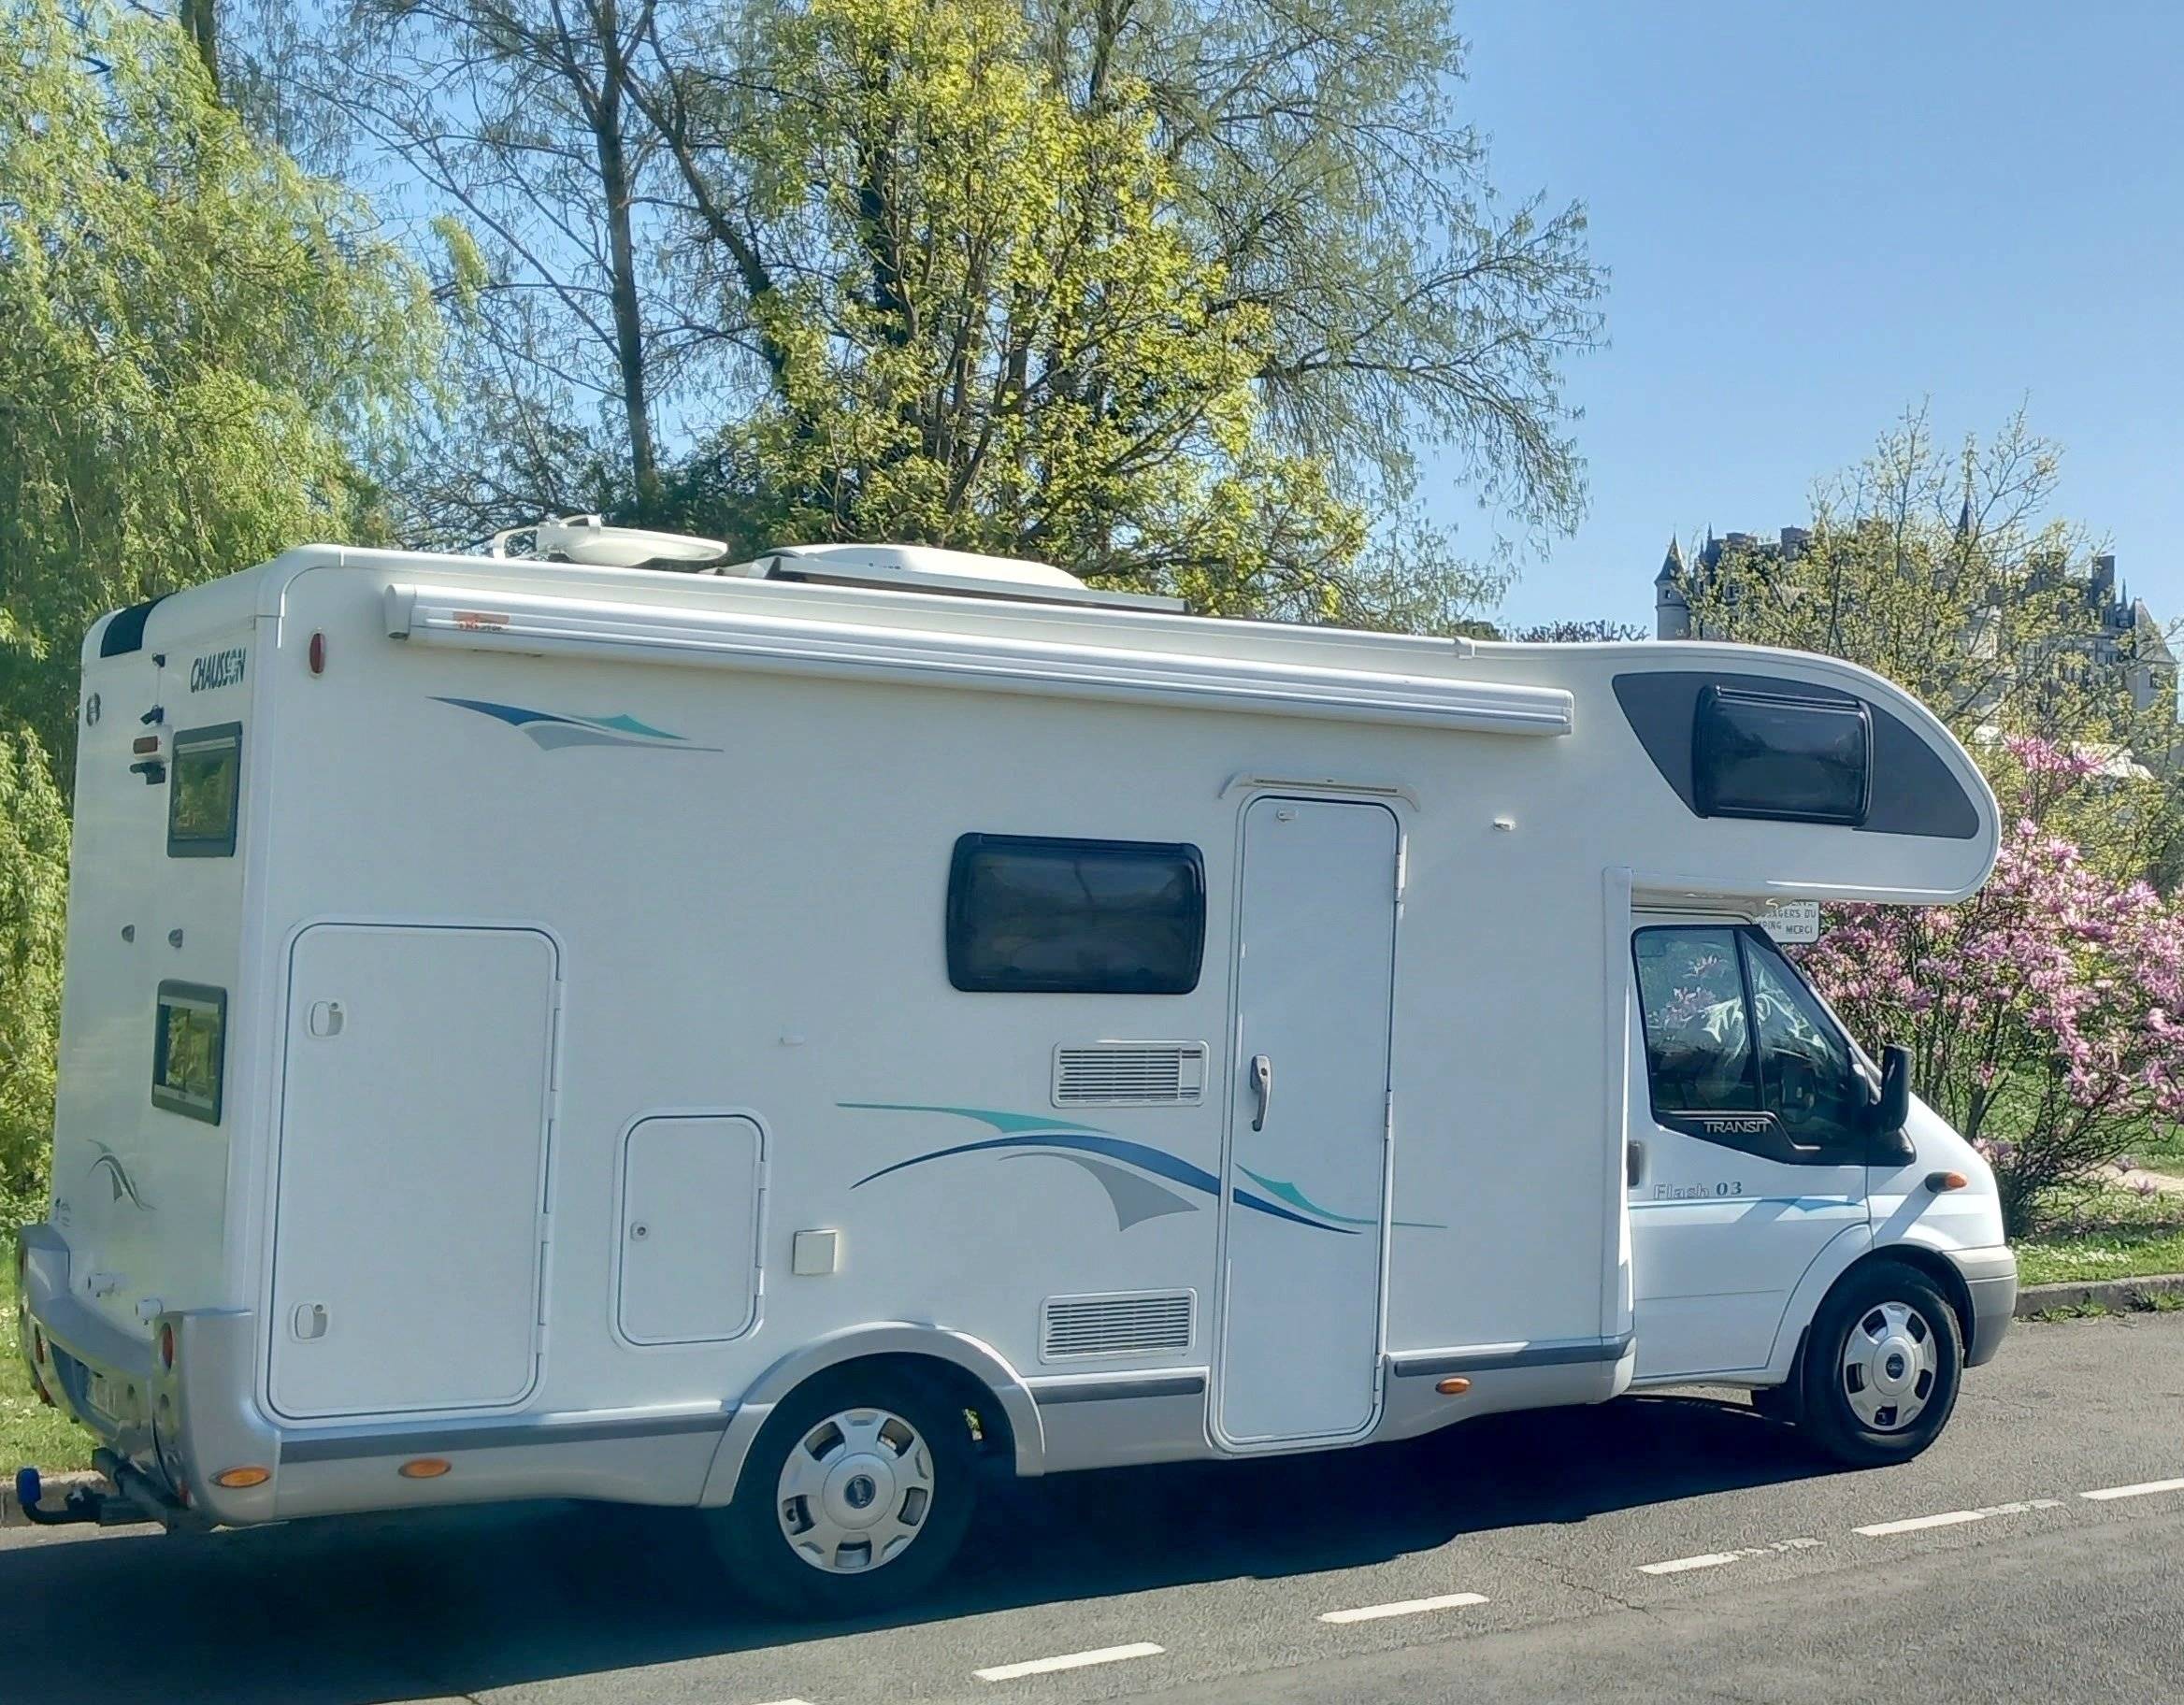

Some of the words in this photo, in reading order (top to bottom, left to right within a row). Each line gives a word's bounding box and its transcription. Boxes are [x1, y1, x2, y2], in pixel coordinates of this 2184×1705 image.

[1786, 924, 1813, 935] MERCI
[1703, 1121, 1768, 1134] TRANSIT
[1653, 1182, 1709, 1201] Flash
